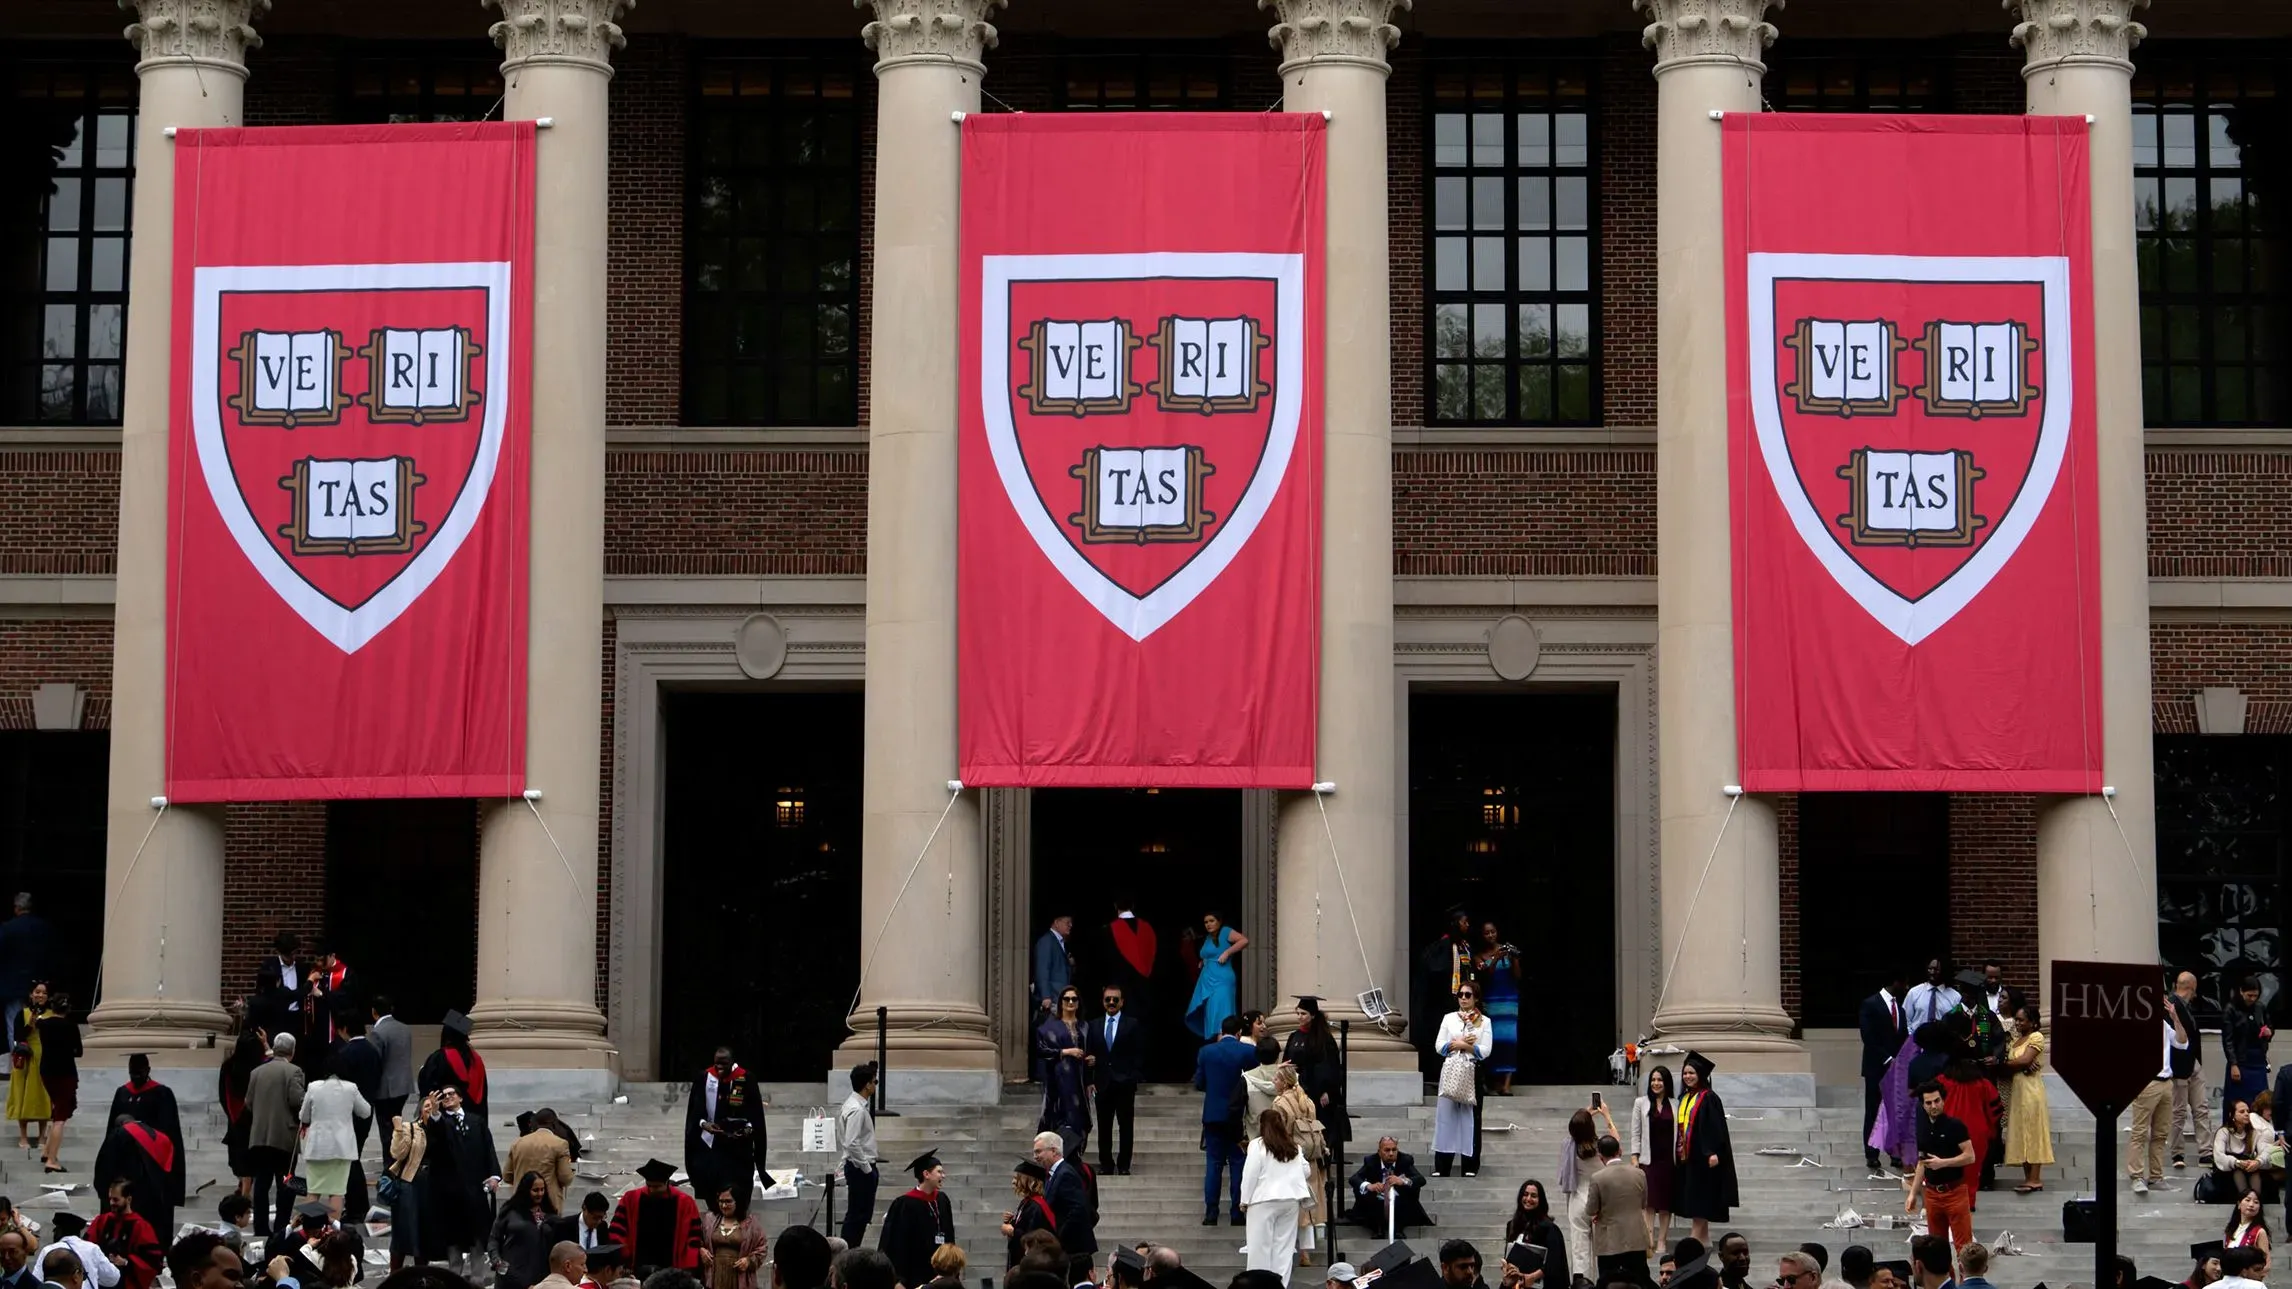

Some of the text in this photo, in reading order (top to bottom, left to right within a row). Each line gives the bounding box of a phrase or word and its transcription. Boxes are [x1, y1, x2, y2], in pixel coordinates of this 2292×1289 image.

[259, 352, 440, 391] VE RI
[1049, 341, 1228, 380] VE RI
[1814, 343, 1995, 383] VE RI
[317, 479, 390, 517] TAS
[1107, 468, 1179, 506] TAS
[1875, 470, 1949, 510] TAS
[2058, 982, 2154, 1021] HMS
[814, 1122, 825, 1150] TATTE
